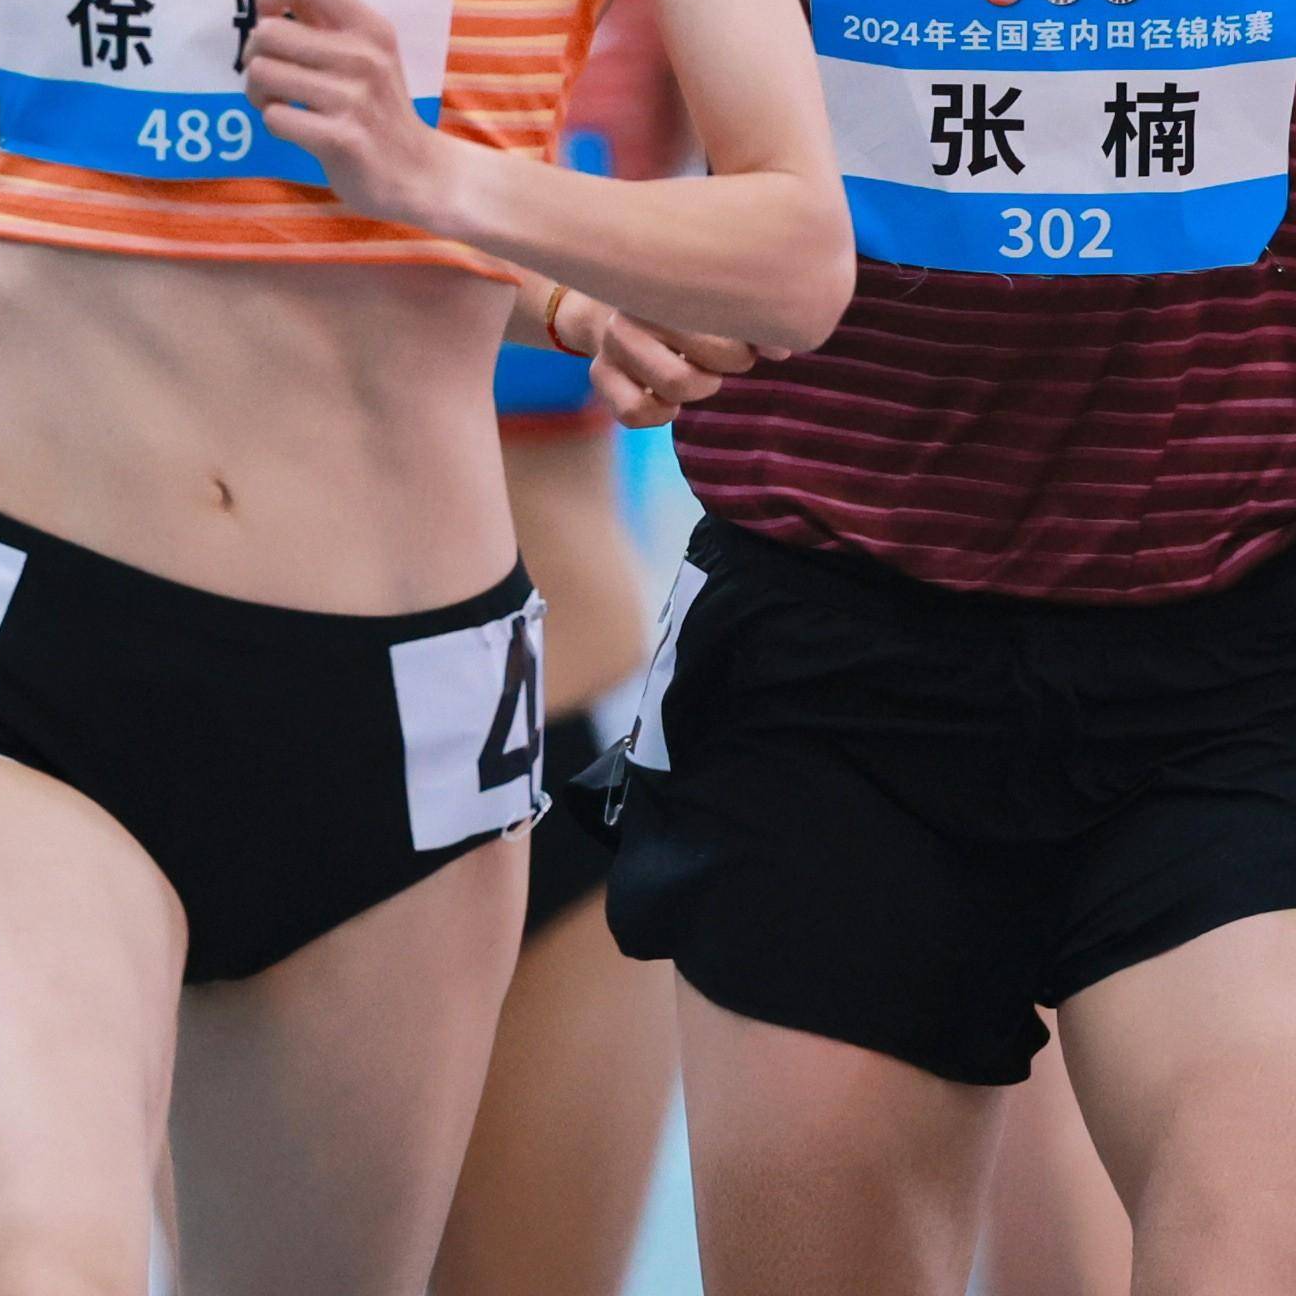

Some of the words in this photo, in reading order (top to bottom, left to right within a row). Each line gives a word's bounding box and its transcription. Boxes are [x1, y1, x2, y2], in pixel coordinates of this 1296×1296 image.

[842, 10, 1275, 52] 2024年全国室内田径锦标赛
[137, 108, 253, 163] 489
[998, 207, 1114, 260] 302
[477, 615, 544, 812] 4
